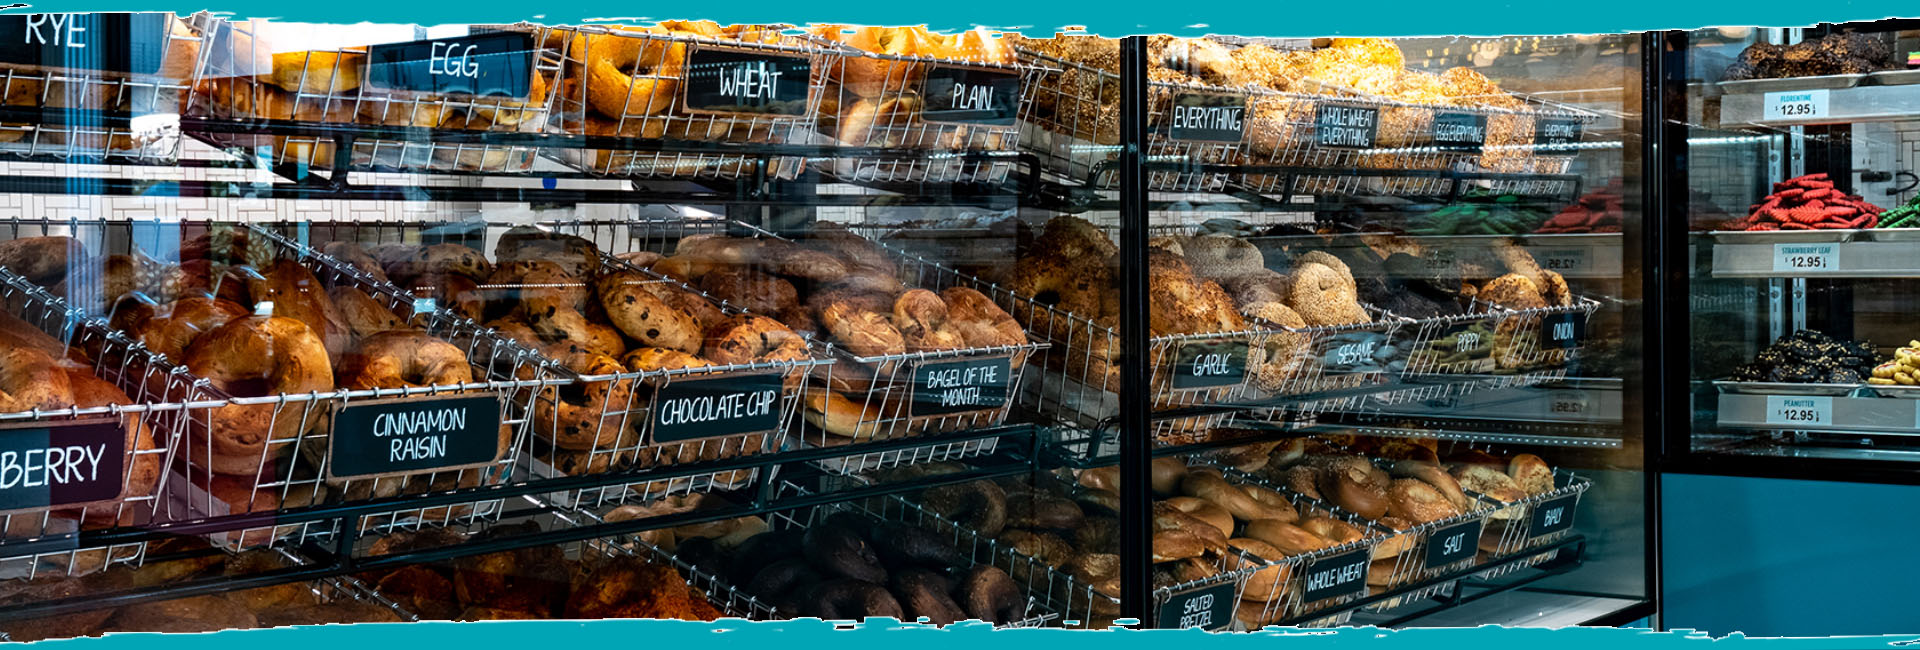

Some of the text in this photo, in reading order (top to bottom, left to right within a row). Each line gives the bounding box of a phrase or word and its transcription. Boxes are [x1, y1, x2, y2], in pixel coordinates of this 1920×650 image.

[25, 13, 85, 47] RYE
[429, 42, 479, 79] EGG
[719, 67, 783, 99] WHEAT
[952, 83, 994, 111] PLAIN
[1780, 94, 1812, 102] FLORENTINE
[1781, 103, 1810, 115] 12.95
[1173, 105, 1241, 132] EVERYTHING
[1321, 106, 1375, 128] WHOLE WHEAT
[1321, 127, 1370, 147] EVERYTHING
[1435, 123, 1484, 143] EGG EVERYTHING
[1791, 256, 1821, 267] 12.95
[1456, 332, 1481, 352] POPPY
[1552, 322, 1575, 341] ONION
[1192, 353, 1232, 377] GARLIC
[1336, 341, 1376, 365] SESAME
[927, 365, 997, 389] BAGEL OF THE
[661, 390, 776, 426] CHOCOLATE CHIP
[941, 387, 980, 407] MONTH
[373, 407, 466, 437] CINNAMON
[1784, 409, 1814, 421] 12.95
[390, 434, 447, 462] RAISIN
[0, 443, 106, 489] BERRY
[1543, 506, 1564, 527] BIALY
[1442, 532, 1465, 556] SALT
[1307, 560, 1365, 592] WHOLE WHEAT
[1183, 593, 1215, 615] SALTED
[1179, 611, 1213, 629] PRETZEL
